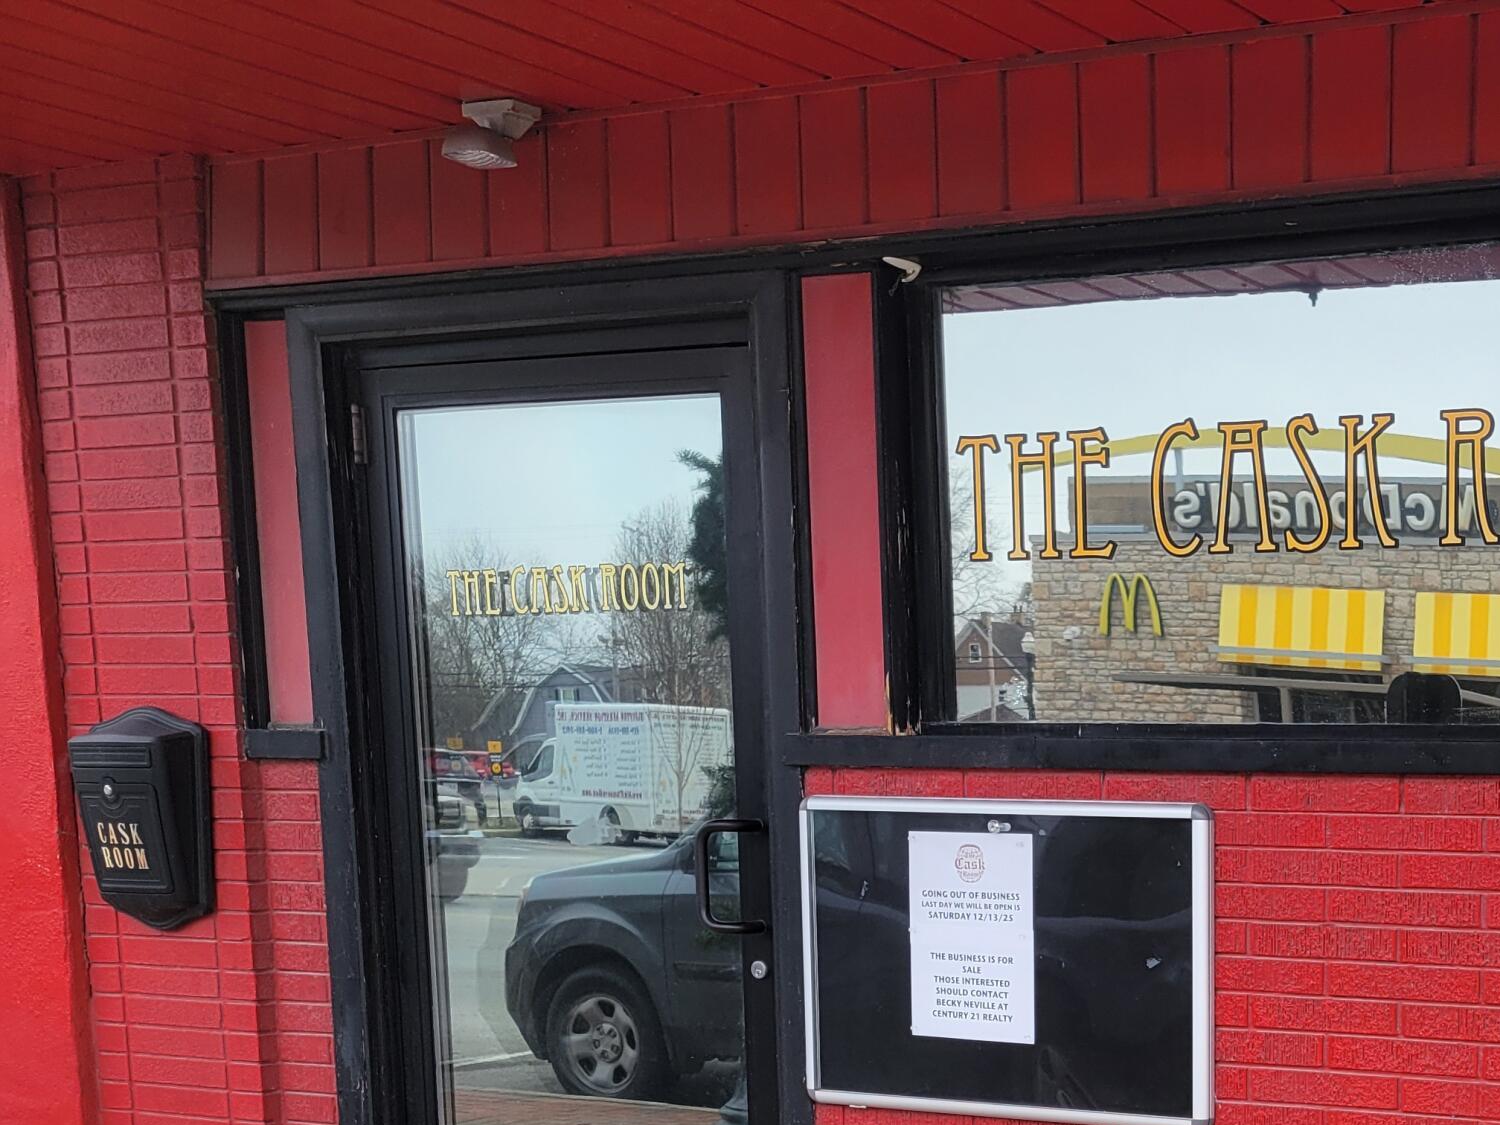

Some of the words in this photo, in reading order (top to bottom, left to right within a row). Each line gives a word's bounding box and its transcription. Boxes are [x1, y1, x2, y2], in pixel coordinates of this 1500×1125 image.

[955, 426, 1117, 561] THE
[1151, 412, 1400, 558] CASK
[446, 568, 501, 616] THE
[510, 565, 590, 615] CASK
[599, 560, 688, 611] ROOM
[97, 822, 143, 845] CASK
[101, 846, 149, 870] ROOM
[955, 858, 986, 870] Cask
[922, 889, 948, 898] GOING
[950, 890, 966, 899] OUT
[969, 891, 980, 899] OF
[981, 892, 1020, 901] BUSINESS
[939, 901, 952, 909] DAY
[928, 911, 971, 921] SATURDAY
[974, 913, 1014, 922] 12/13/25
[930, 952, 946, 960] THE
[948, 953, 986, 963] BUSINESS
[997, 956, 1014, 964] FOR
[962, 965, 981, 974] SALE
[934, 975, 960, 984] THOSE
[962, 977, 1010, 988] INTERESTED
[936, 987, 968, 996] SHOULD
[970, 989, 1008, 999] CONTACT
[936, 998, 961, 1007] BECKY
[964, 1000, 995, 1010] NEVILLE
[997, 1003, 1008, 1011] AT
[932, 1009, 968, 1020] CENTURY
[970, 1012, 980, 1020] 21
[982, 1013, 1013, 1023] REALTY
